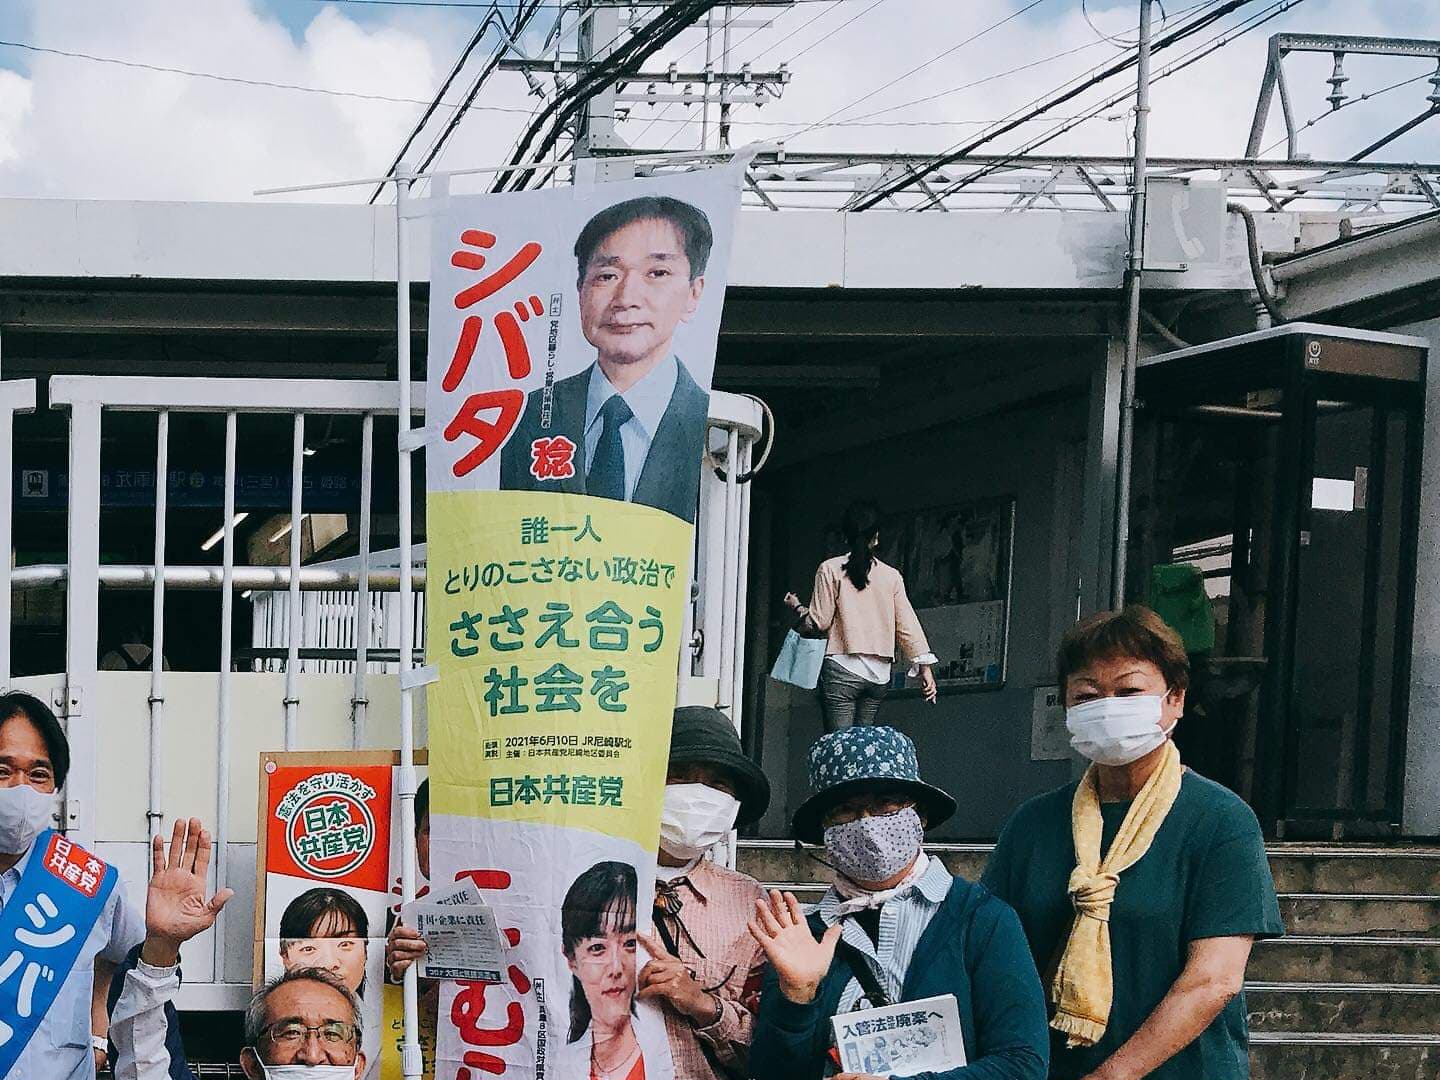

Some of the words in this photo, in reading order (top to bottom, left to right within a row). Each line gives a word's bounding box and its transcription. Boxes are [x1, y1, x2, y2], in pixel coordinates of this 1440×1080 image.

[442, 229, 545, 478] シバタ
[532, 437, 576, 480] 稔
[521, 515, 602, 545] 誰一人
[444, 555, 676, 595] とりのこさない政治で
[449, 600, 665, 658] ささえ合う
[482, 662, 630, 717] 社会を
[505, 735, 578, 748] 2021年6月10日
[490, 774, 624, 807] 日本共産党
[305, 803, 349, 832] 日本
[55, 838, 102, 876] 日本
[299, 826, 367, 862] 共産党
[49, 852, 97, 893] 共産党
